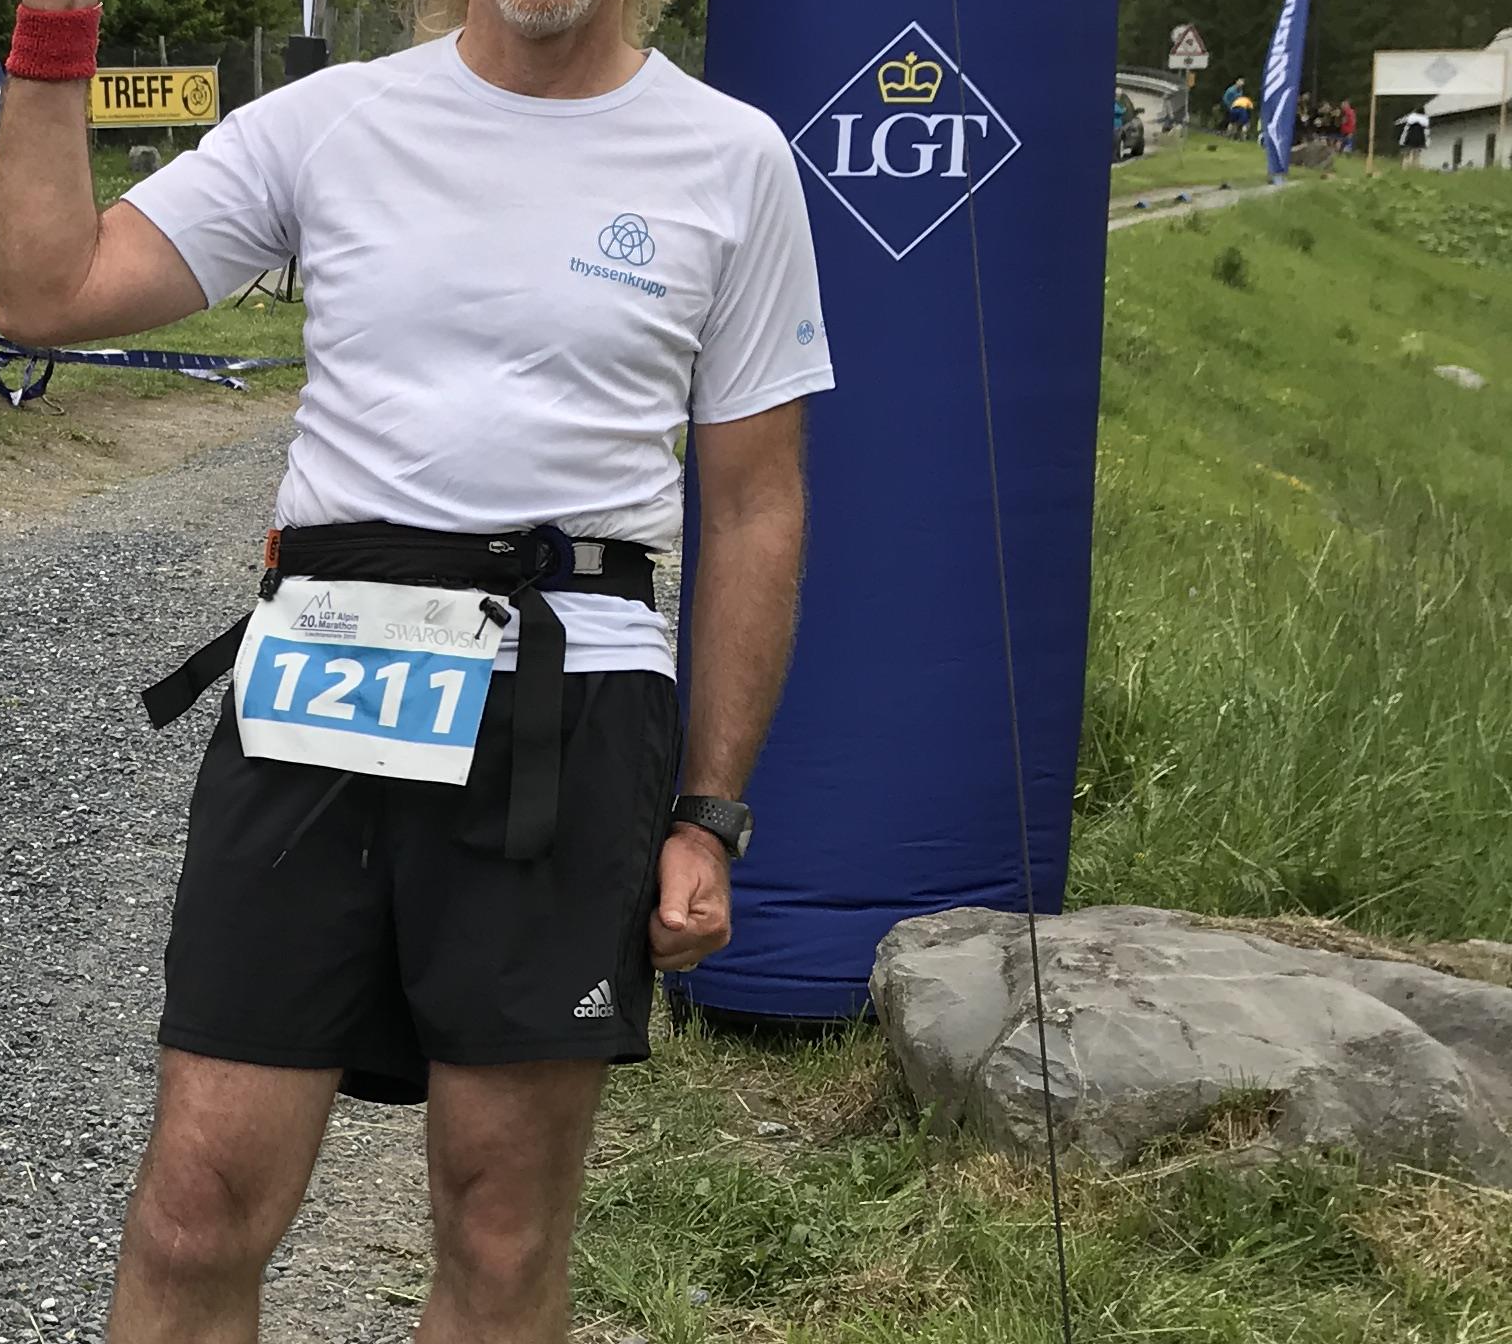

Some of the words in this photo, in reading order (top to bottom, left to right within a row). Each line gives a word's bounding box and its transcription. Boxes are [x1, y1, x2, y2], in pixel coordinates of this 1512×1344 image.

[99, 75, 173, 109] TREFF
[828, 112, 988, 178] LGT
[569, 256, 667, 298] thyssenkrupp
[300, 614, 318, 628] 20.
[318, 620, 358, 630] Marathon
[384, 623, 488, 650] SWAROVSKI
[272, 652, 466, 735] 1211
[573, 1003, 615, 1018] adidas
